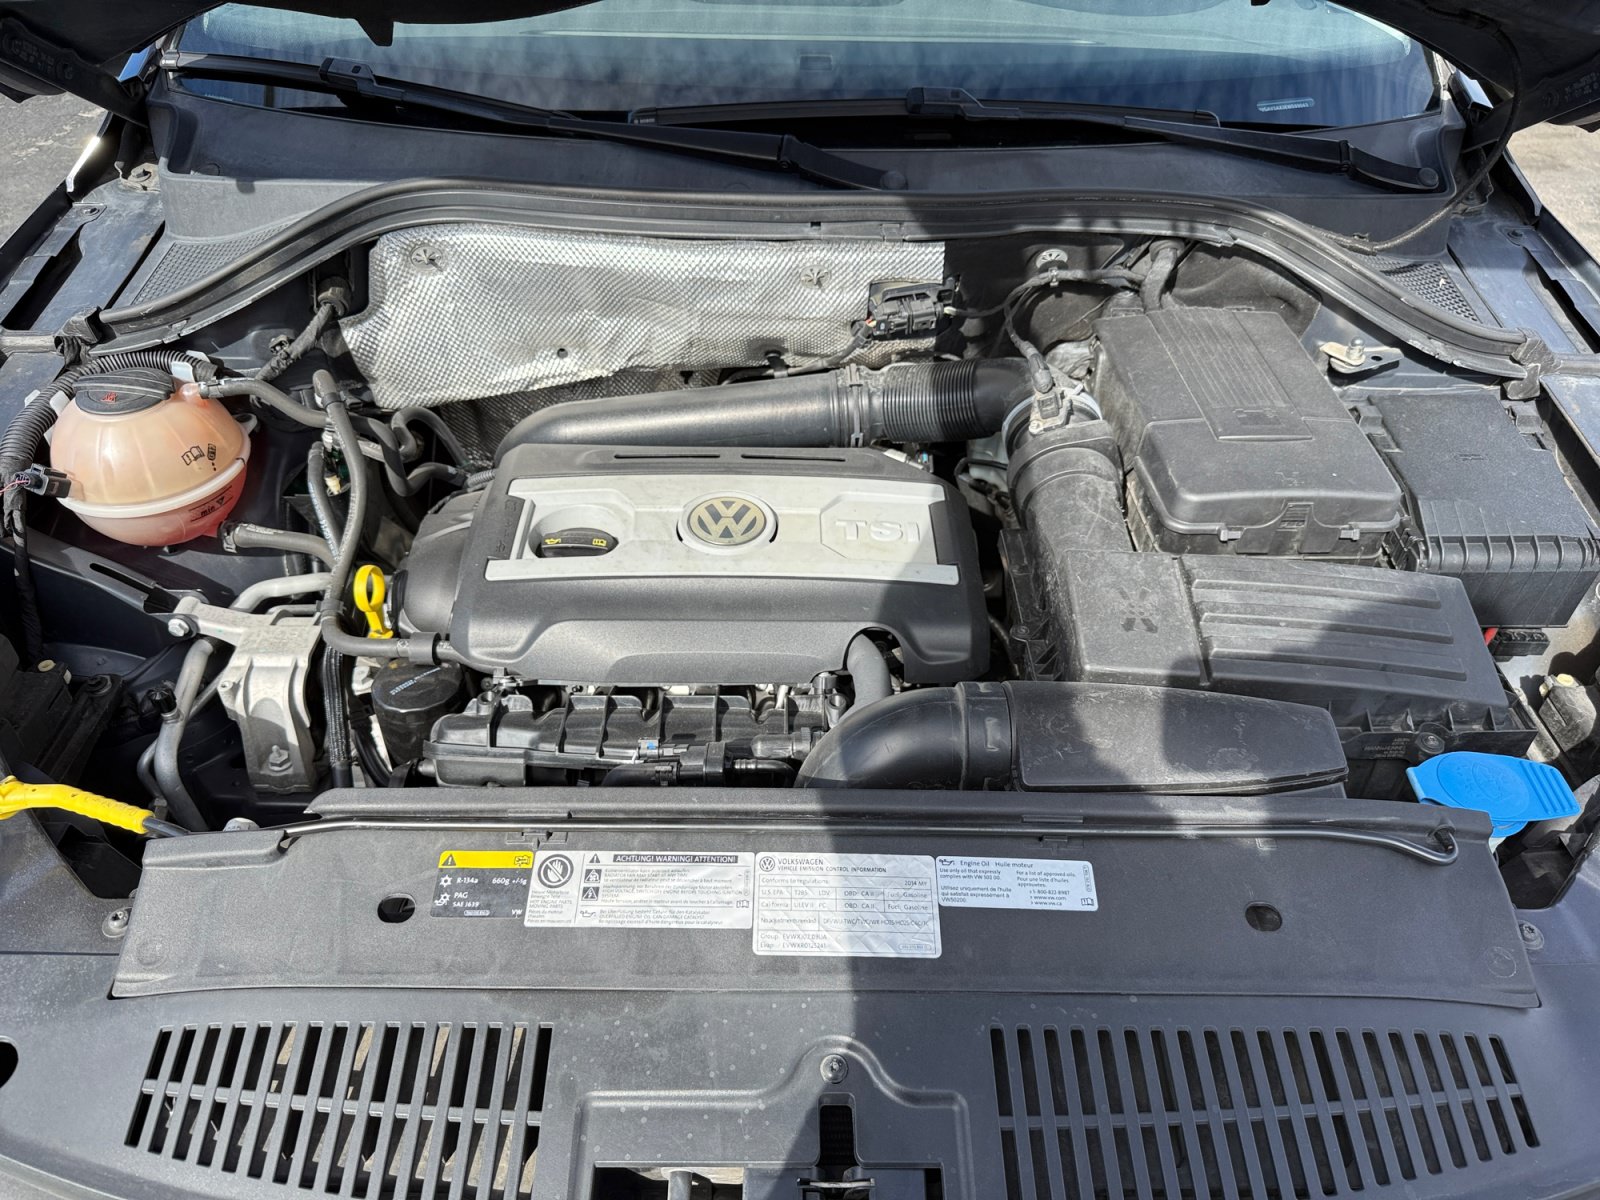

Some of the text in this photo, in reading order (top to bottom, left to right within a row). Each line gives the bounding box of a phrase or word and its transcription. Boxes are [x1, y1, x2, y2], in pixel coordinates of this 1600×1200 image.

[200, 505, 215, 517] min
[834, 519, 920, 542] TSI
[491, 877, 510, 886] 660g
